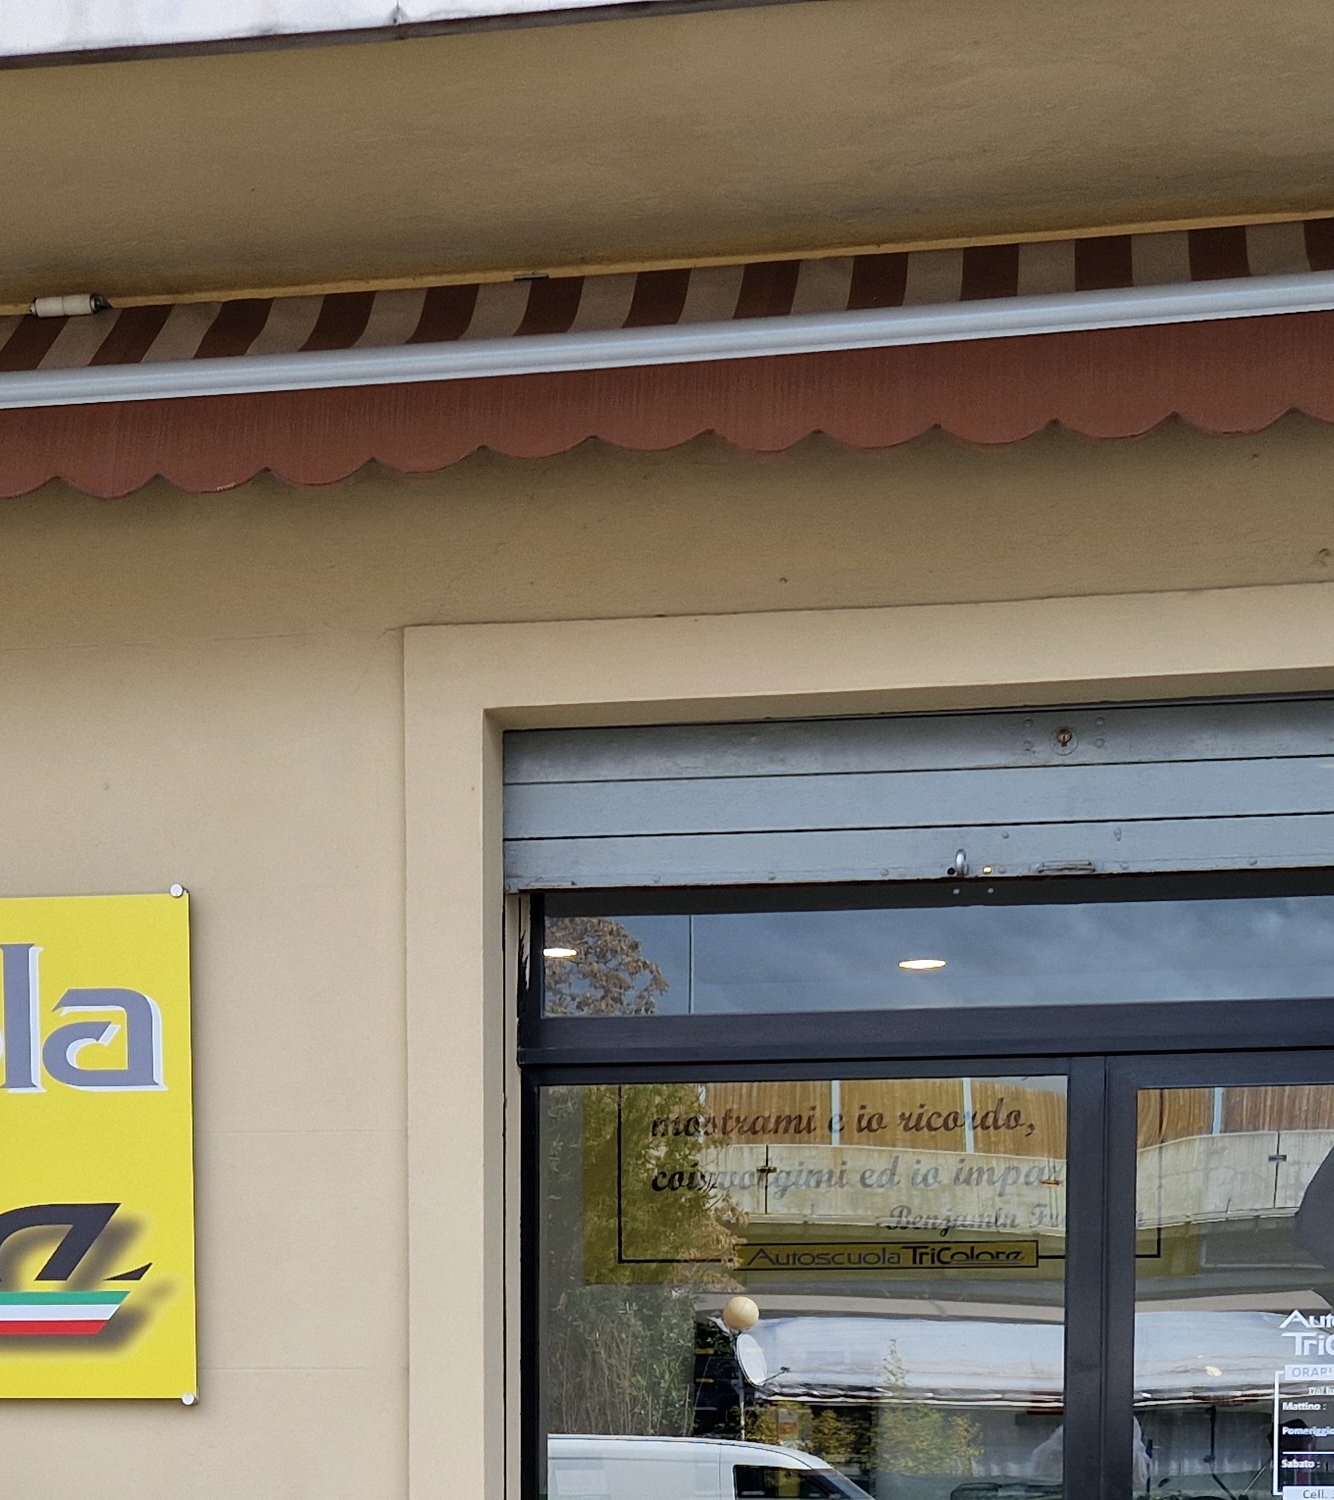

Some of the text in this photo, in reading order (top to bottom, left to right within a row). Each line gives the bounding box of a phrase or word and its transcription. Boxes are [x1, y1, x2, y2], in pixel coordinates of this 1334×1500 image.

[747, 1246, 1025, 1265] Autoscuola TriColore
[1292, 1367, 1330, 1377] ORARI
[1302, 1489, 1327, 1499] Cell.
